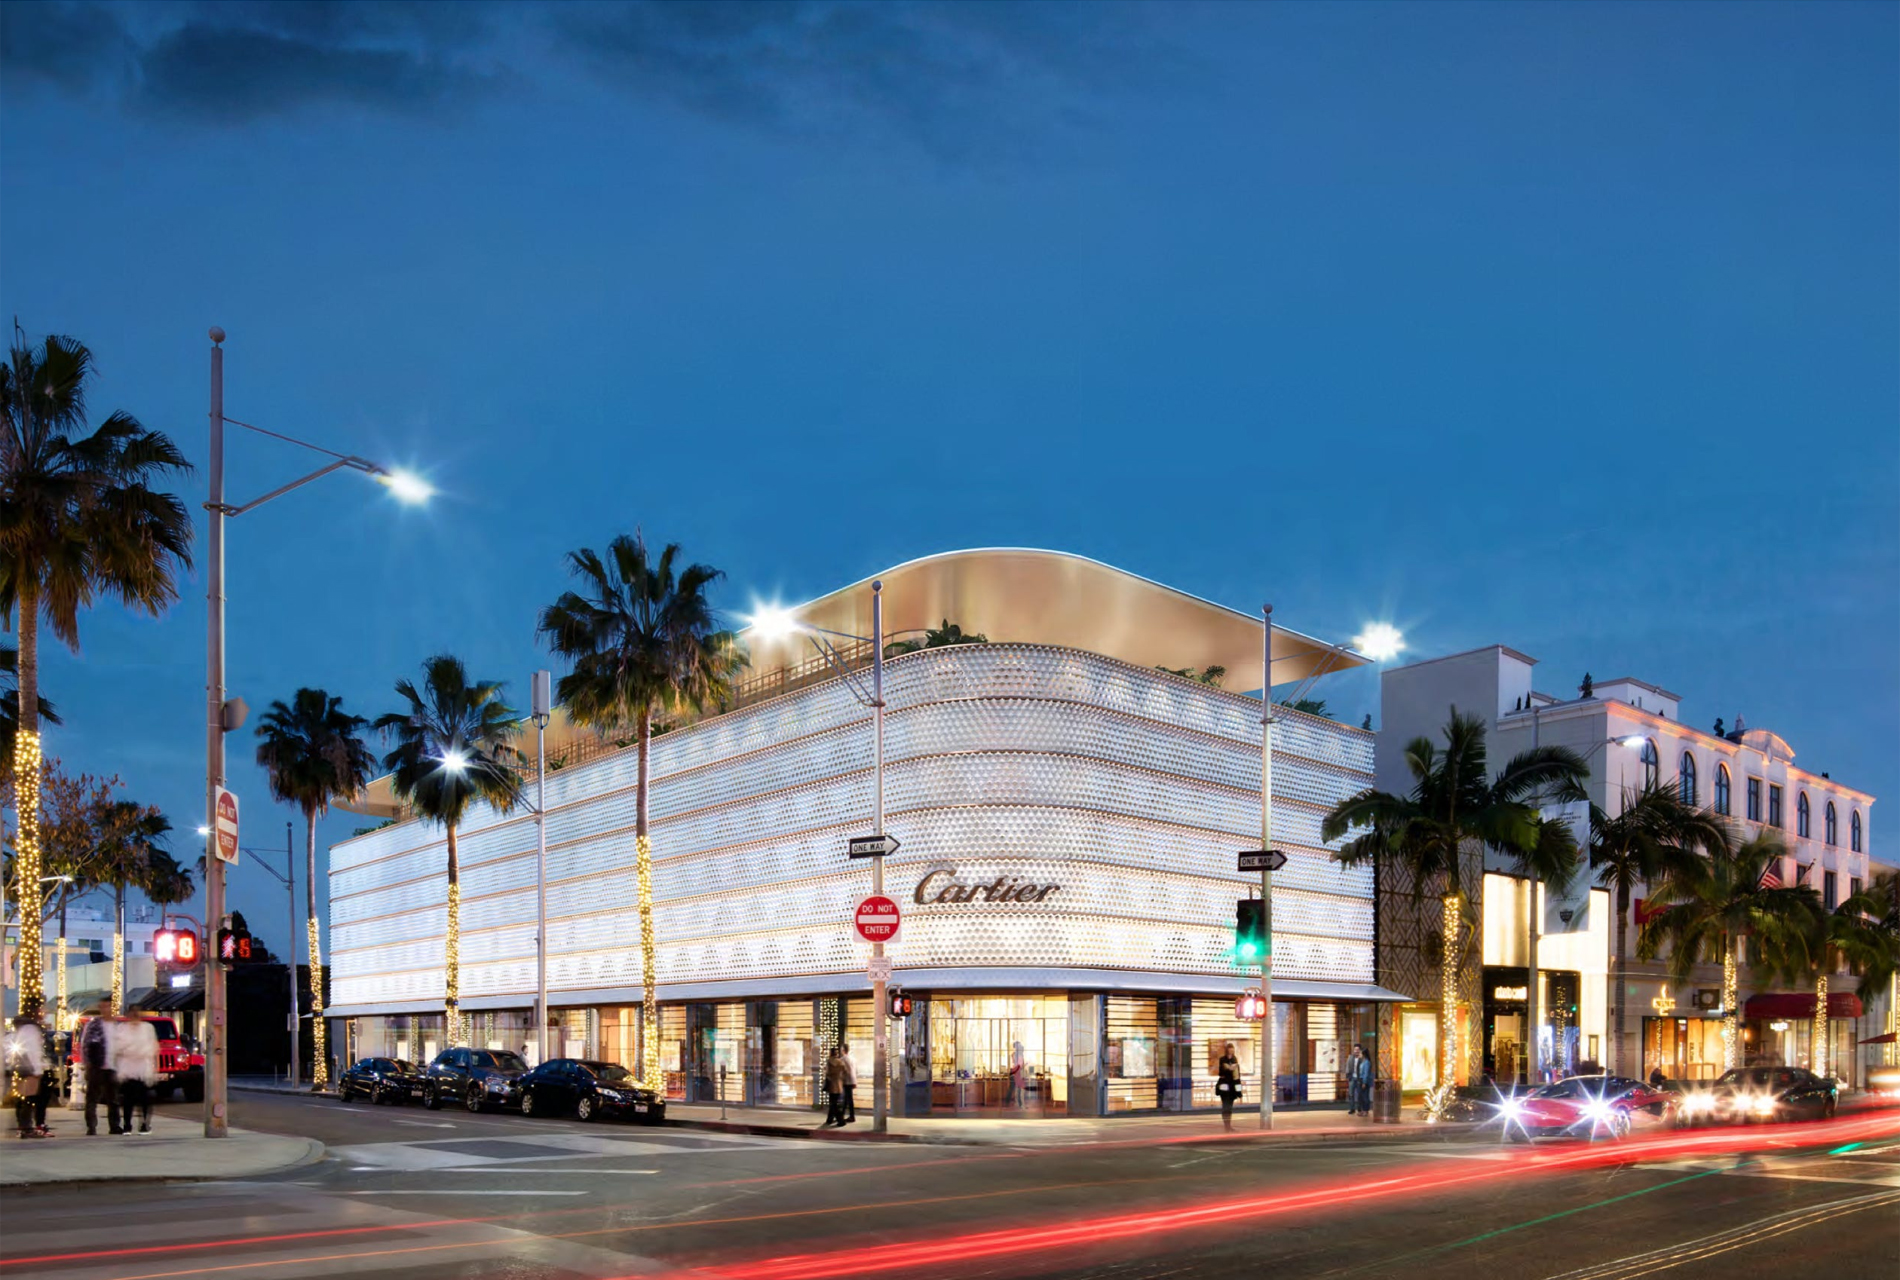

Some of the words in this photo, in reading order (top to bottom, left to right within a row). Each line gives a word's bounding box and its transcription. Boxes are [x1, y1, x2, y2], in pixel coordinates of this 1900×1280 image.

[219, 802, 226, 814] DO
[227, 806, 236, 819] NOT
[221, 833, 234, 848] ENTER
[853, 843, 868, 852] ONE
[869, 841, 885, 850] WAY
[1241, 857, 1256, 866] ONE
[1257, 856, 1272, 865] WAY
[914, 868, 1060, 905] Cartier
[862, 904, 874, 913] DO
[877, 904, 894, 913] NOT
[865, 925, 891, 934] ENTER
